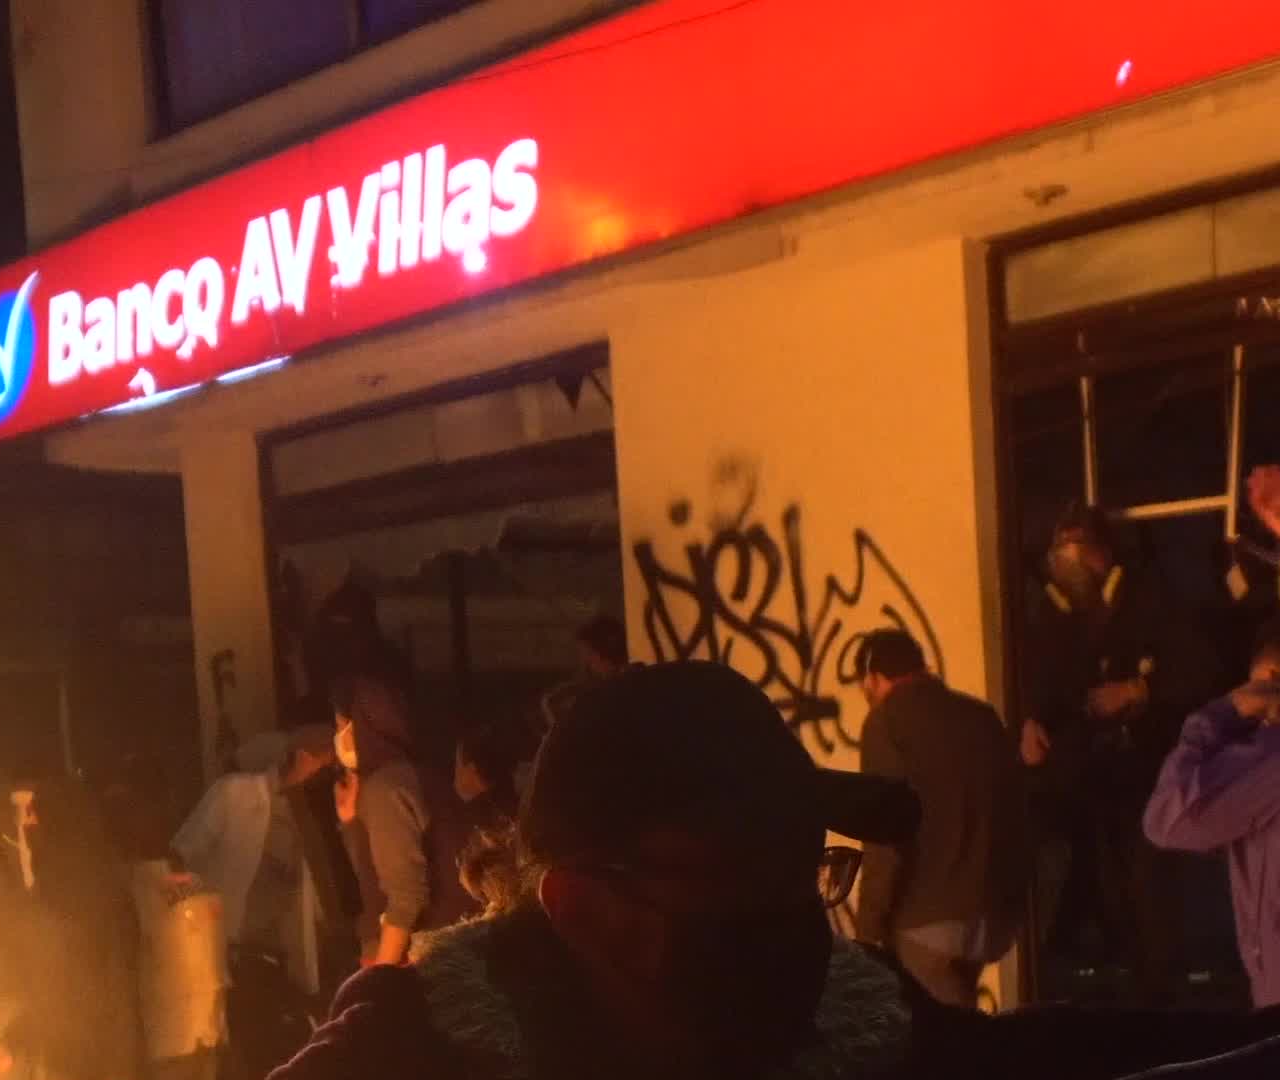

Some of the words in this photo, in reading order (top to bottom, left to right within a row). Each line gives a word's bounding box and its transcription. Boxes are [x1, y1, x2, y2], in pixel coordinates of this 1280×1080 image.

[48, 256, 222, 386] Banco
[230, 196, 321, 322] AV
[326, 139, 539, 288] Villas
